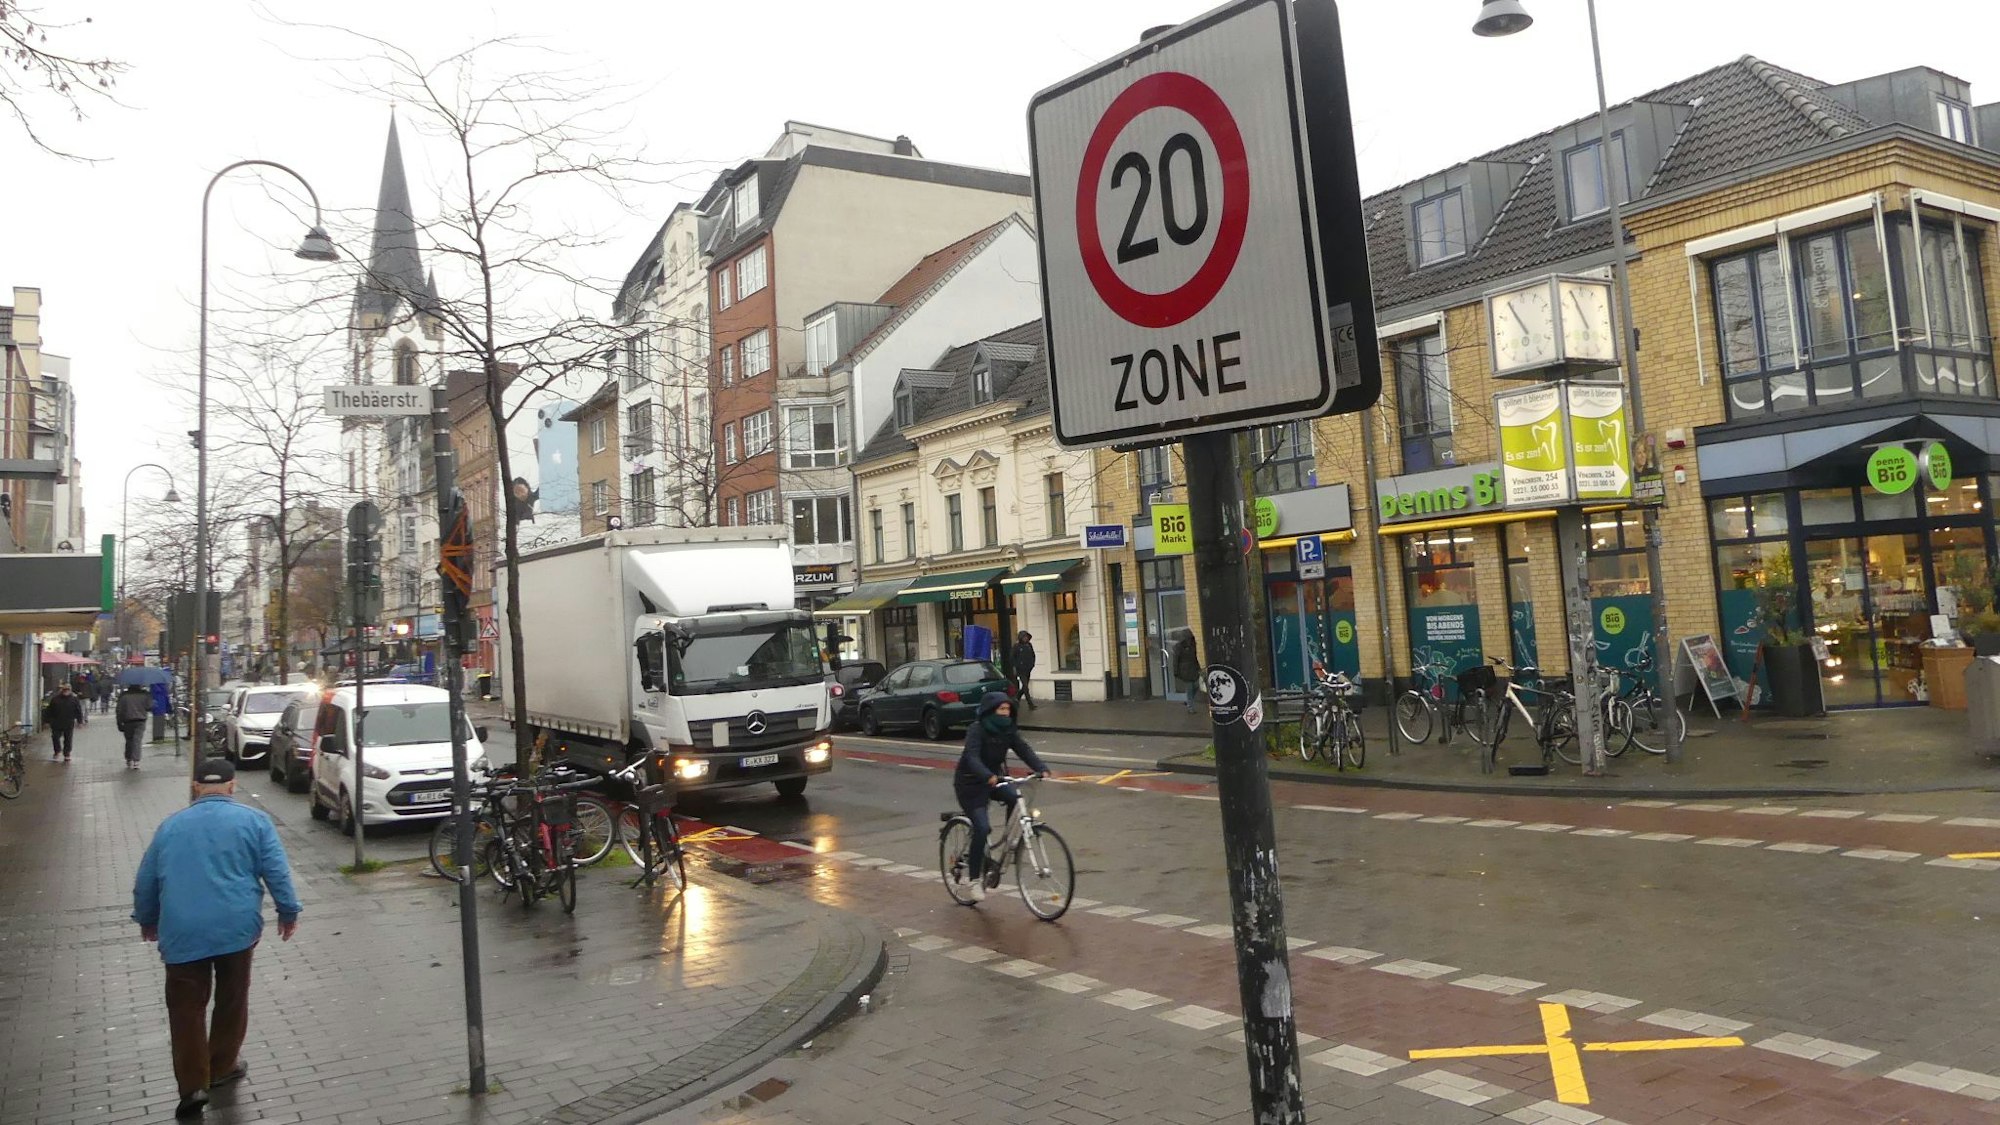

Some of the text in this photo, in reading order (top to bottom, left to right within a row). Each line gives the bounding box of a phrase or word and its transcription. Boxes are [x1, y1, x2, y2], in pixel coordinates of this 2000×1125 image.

[1110, 132, 1209, 265] 20
[1110, 331, 1247, 412] ZONE
[332, 390, 423, 408] Thebäerstr.
[1545, 472, 1558, 482] 254
[1604, 470, 1615, 478] 254
[1877, 465, 1907, 484] Bio
[1160, 515, 1186, 533] Bio
[1161, 534, 1188, 544] Markt
[793, 573, 834, 583] RZUM
[1605, 613, 1620, 623] Bio
[1437, 621, 1465, 629] ABENDS
